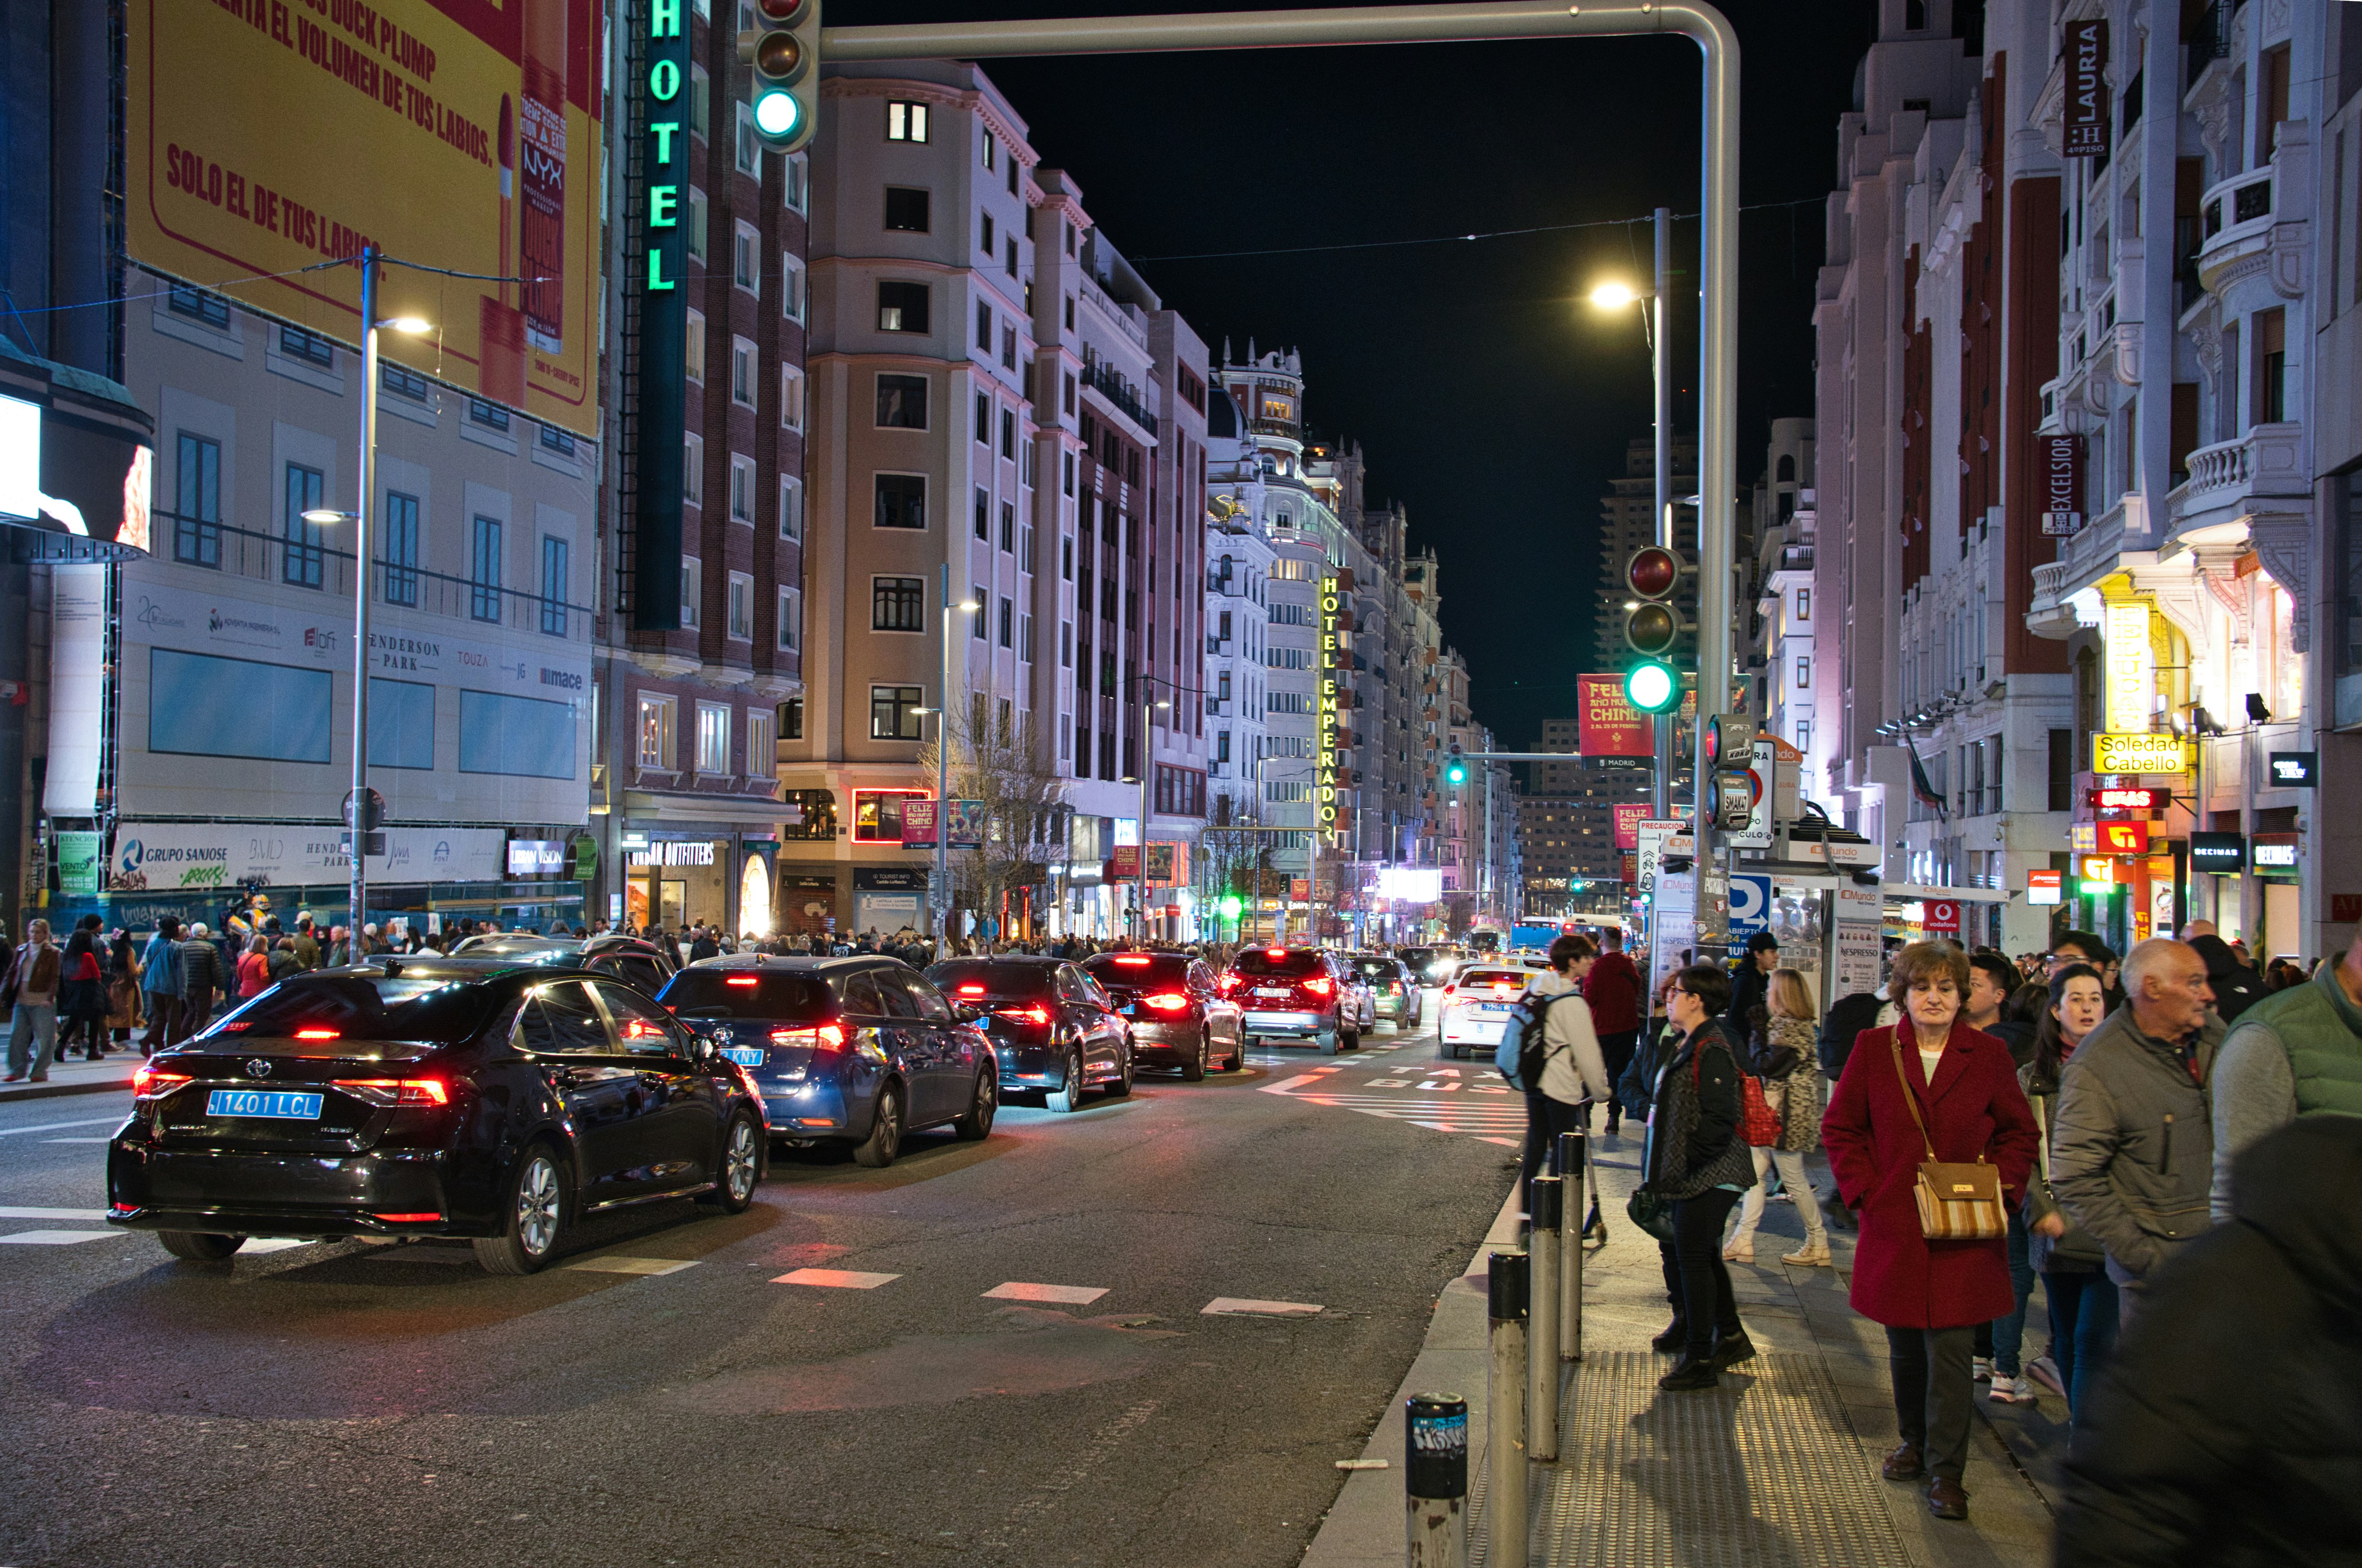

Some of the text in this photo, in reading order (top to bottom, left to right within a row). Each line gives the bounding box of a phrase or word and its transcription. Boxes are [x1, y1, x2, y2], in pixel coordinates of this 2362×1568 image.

[331, 0, 377, 50] DUCK
[380, 16, 436, 84] PLUMP
[2078, 25, 2097, 122] LAURIA
[271, 0, 294, 50] EL
[297, 15, 380, 102] VOLUMEN
[383, 68, 403, 114] DE
[405, 83, 434, 133] TUS
[436, 102, 493, 168] LABIOS.
[648, 0, 680, 290] HOTEL
[524, 144, 561, 190] NYX
[167, 143, 222, 207] SOLO
[226, 170, 250, 220] EL
[254, 184, 278, 233] DE
[281, 197, 316, 249] TUS
[2051, 438, 2072, 512] EXCELSIOR
[304, 626, 337, 650] aloft
[369, 633, 440, 656] ENDERSON
[384, 654, 417, 671] PARK
[457, 651, 488, 667] TOUZA
[2113, 606, 2141, 729] PELUCAS
[551, 669, 582, 691] mace
[1589, 683, 1624, 697] FEL
[1590, 697, 1609, 706] AÑO
[1321, 578, 1338, 840] HOTEL EMPERADOR
[1591, 708, 1641, 721] CHINO
[2101, 737, 2178, 751] Soledad
[1729, 750, 1750, 759] KOKO
[1776, 749, 1794, 759] ndo
[2104, 755, 2176, 770] Cabello
[146, 848, 227, 862] GRUPO SANJOSE
[307, 843, 343, 854] HENDE
[665, 842, 714, 866] OUTFITTERS
[1829, 846, 1857, 855] undo
[324, 856, 350, 867] PARK
[538, 850, 562, 864] VISION
[1645, 877, 1652, 886] 30
[1673, 881, 1693, 889] Mun
[1851, 890, 1876, 901] Mundo
[1661, 936, 1693, 945] NESPRESS
[1840, 946, 1878, 957] NESPRESSO
[733, 1051, 758, 1063] KNY
[1389, 1066, 1505, 1079] TAX
[1362, 1078, 1511, 1094] BUS
[225, 1093, 315, 1116] 1401 LCL
